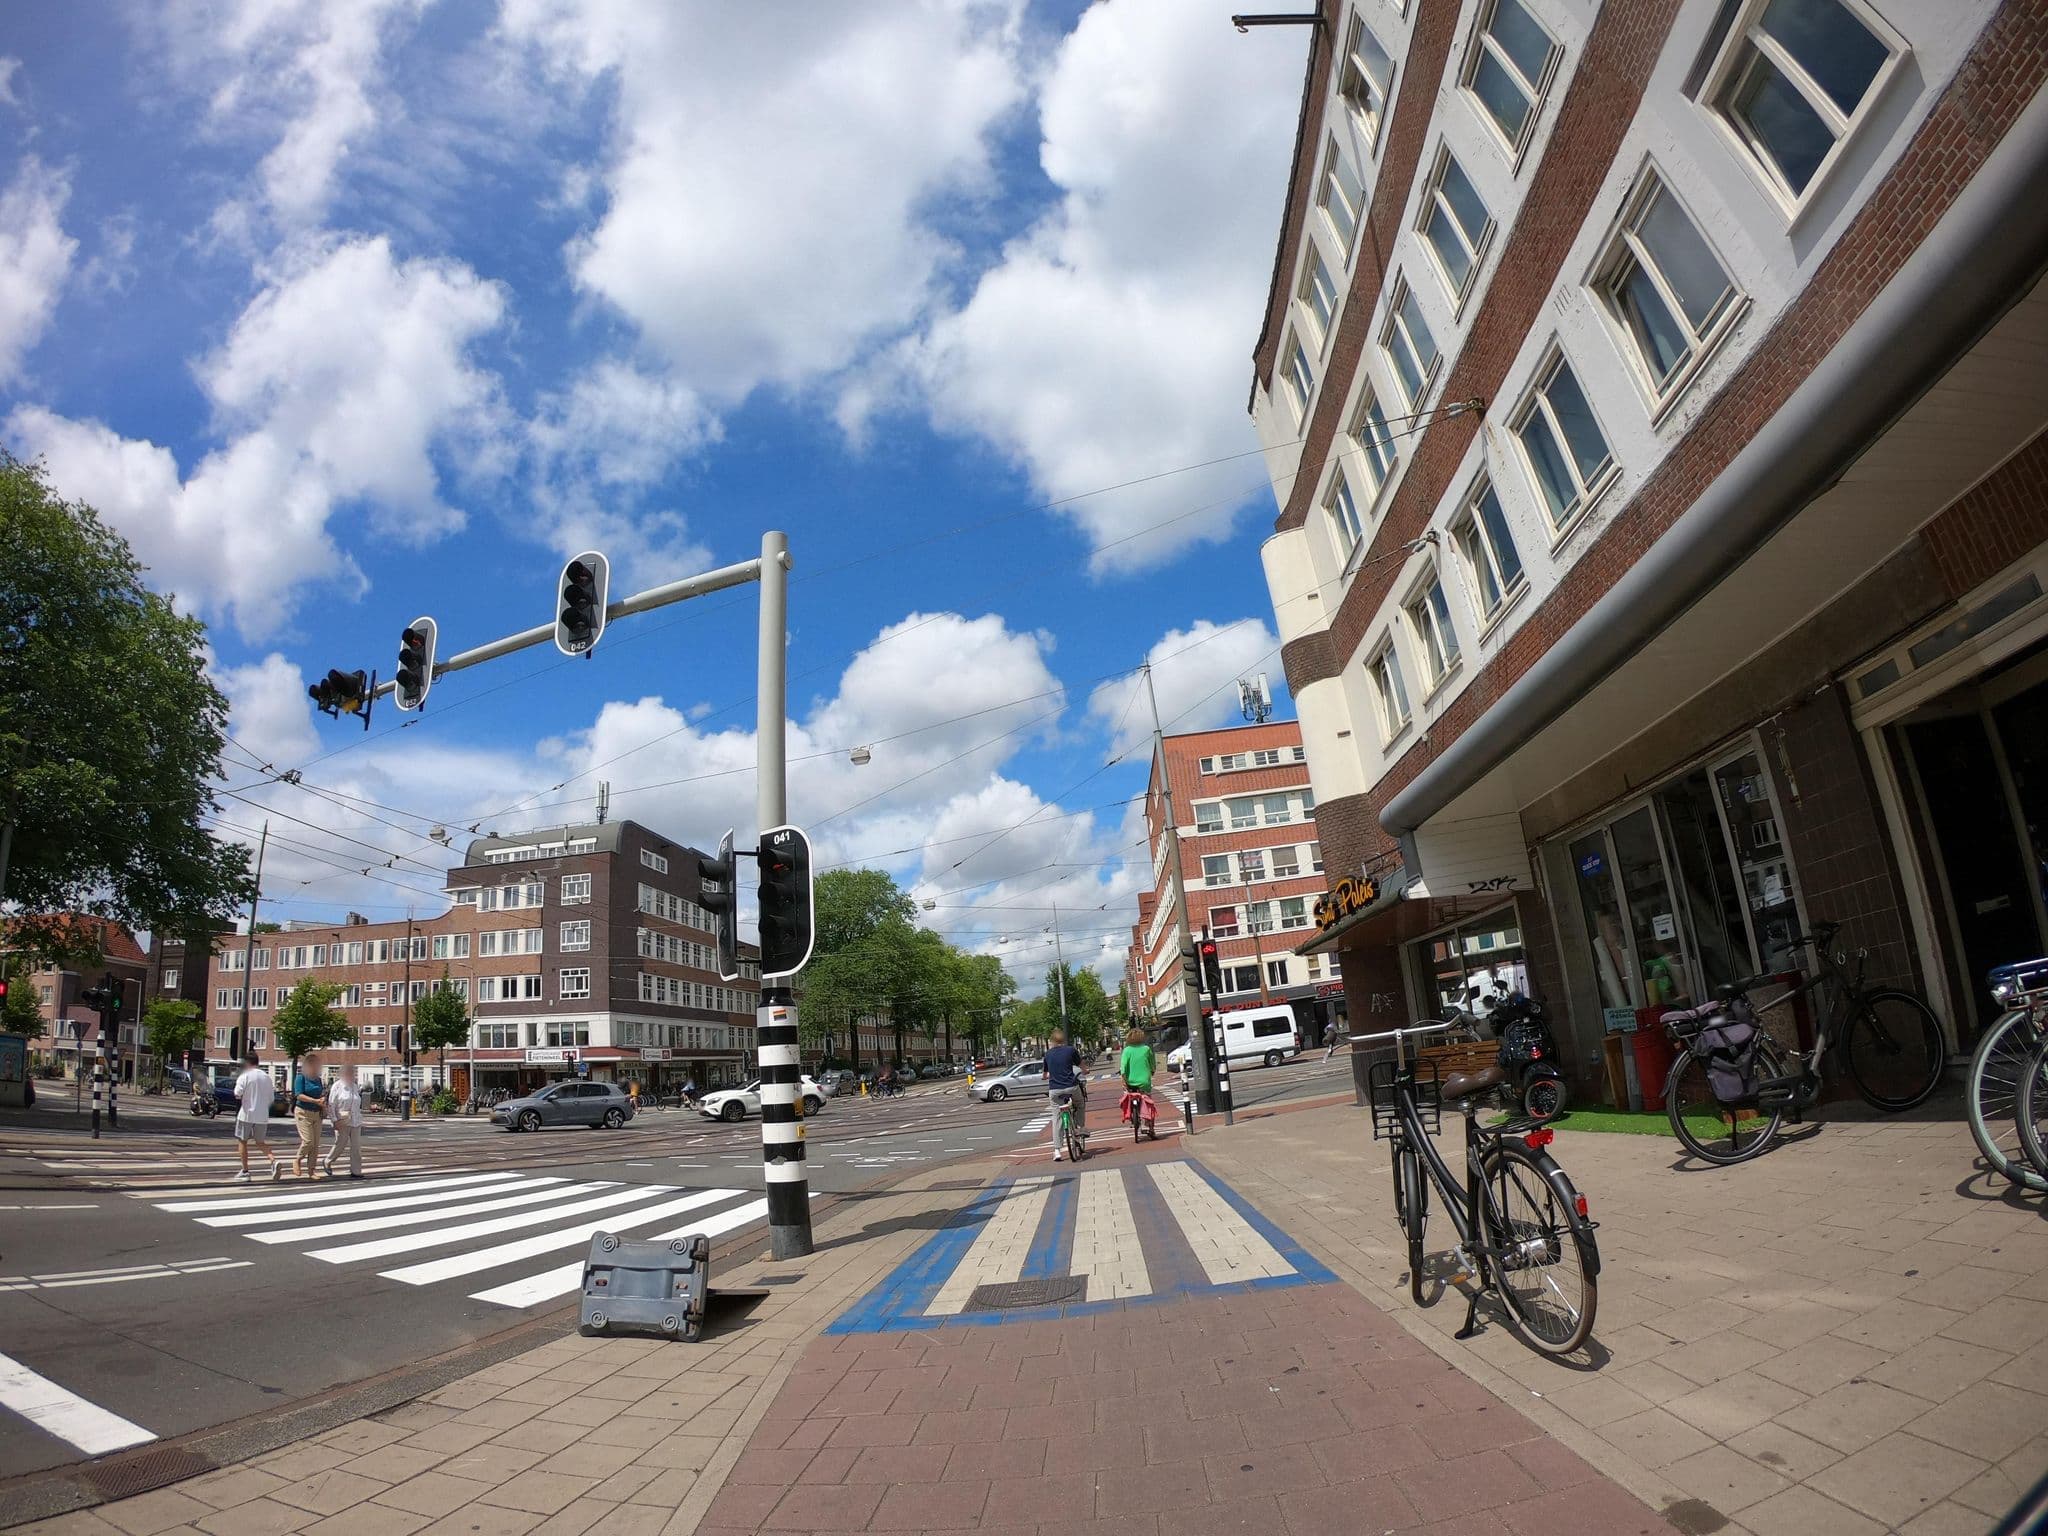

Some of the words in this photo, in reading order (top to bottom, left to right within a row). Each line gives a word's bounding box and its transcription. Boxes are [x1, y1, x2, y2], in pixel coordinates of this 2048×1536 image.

[571, 641, 586, 651] 042
[773, 831, 790, 845] 041
[1335, 879, 1374, 914] Paleis
